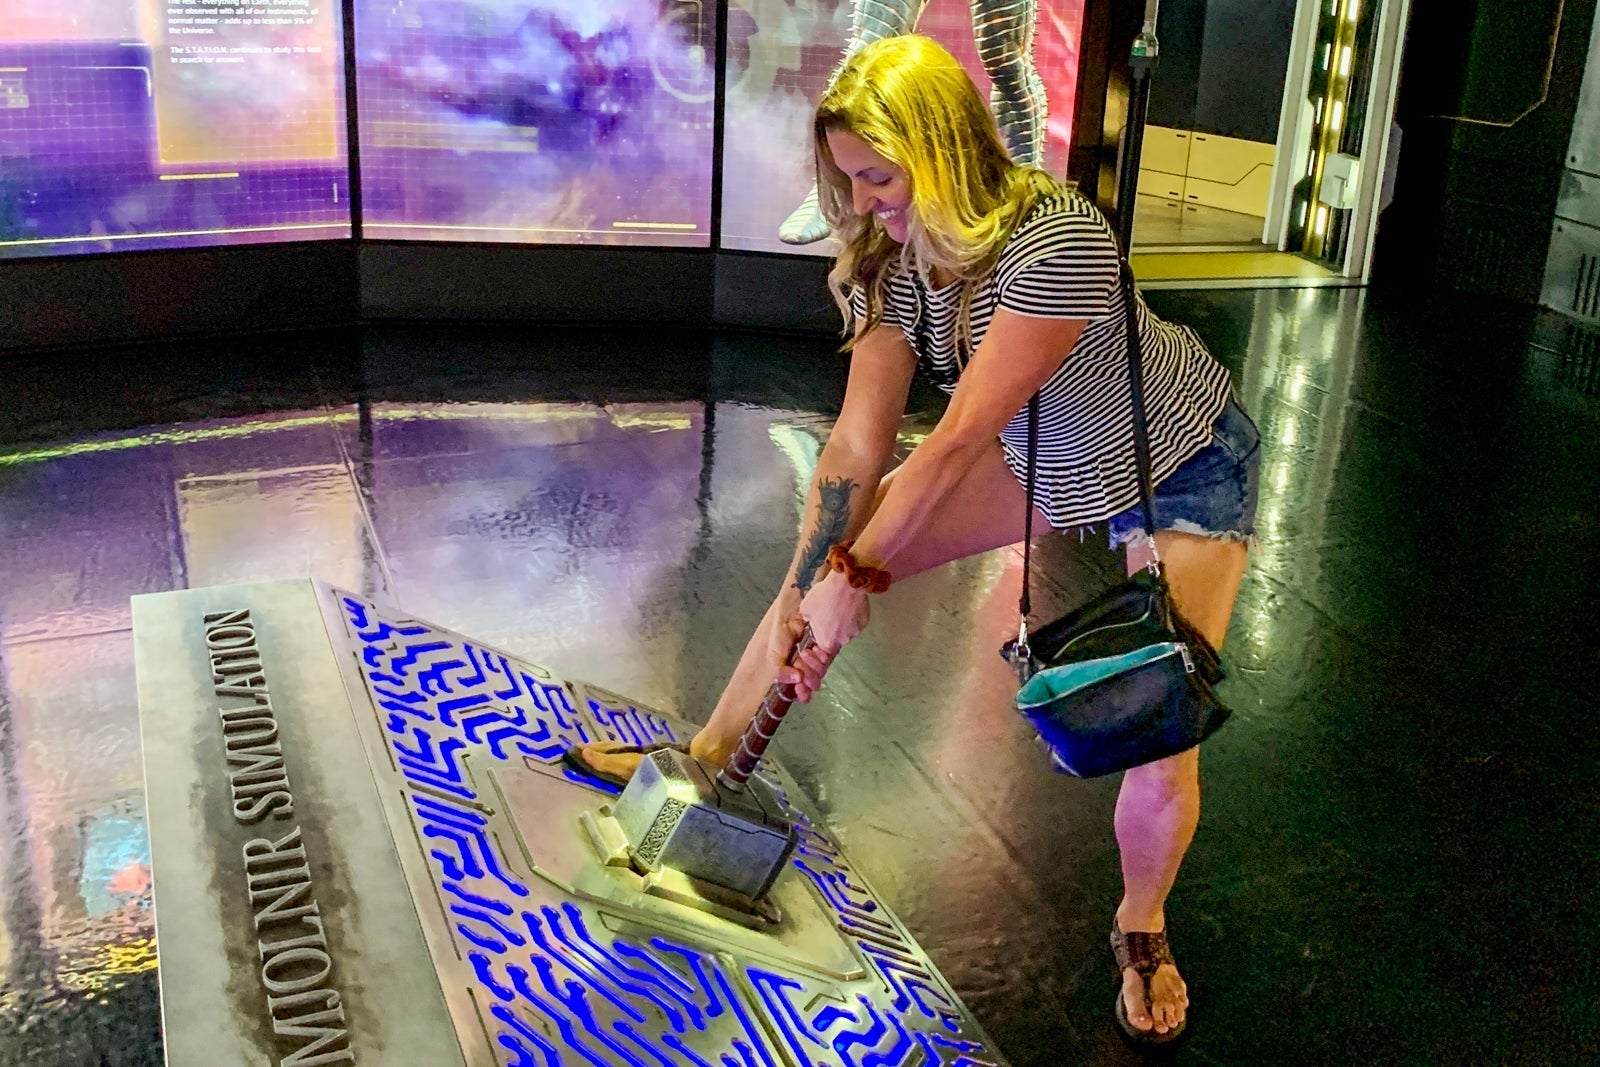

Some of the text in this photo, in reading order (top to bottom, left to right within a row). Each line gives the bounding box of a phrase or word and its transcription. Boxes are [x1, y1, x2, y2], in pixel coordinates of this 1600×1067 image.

[182, 26, 216, 34] Universe.
[179, 56, 203, 64] search
[202, 608, 355, 1067] MJOLNIR SIMULATION
